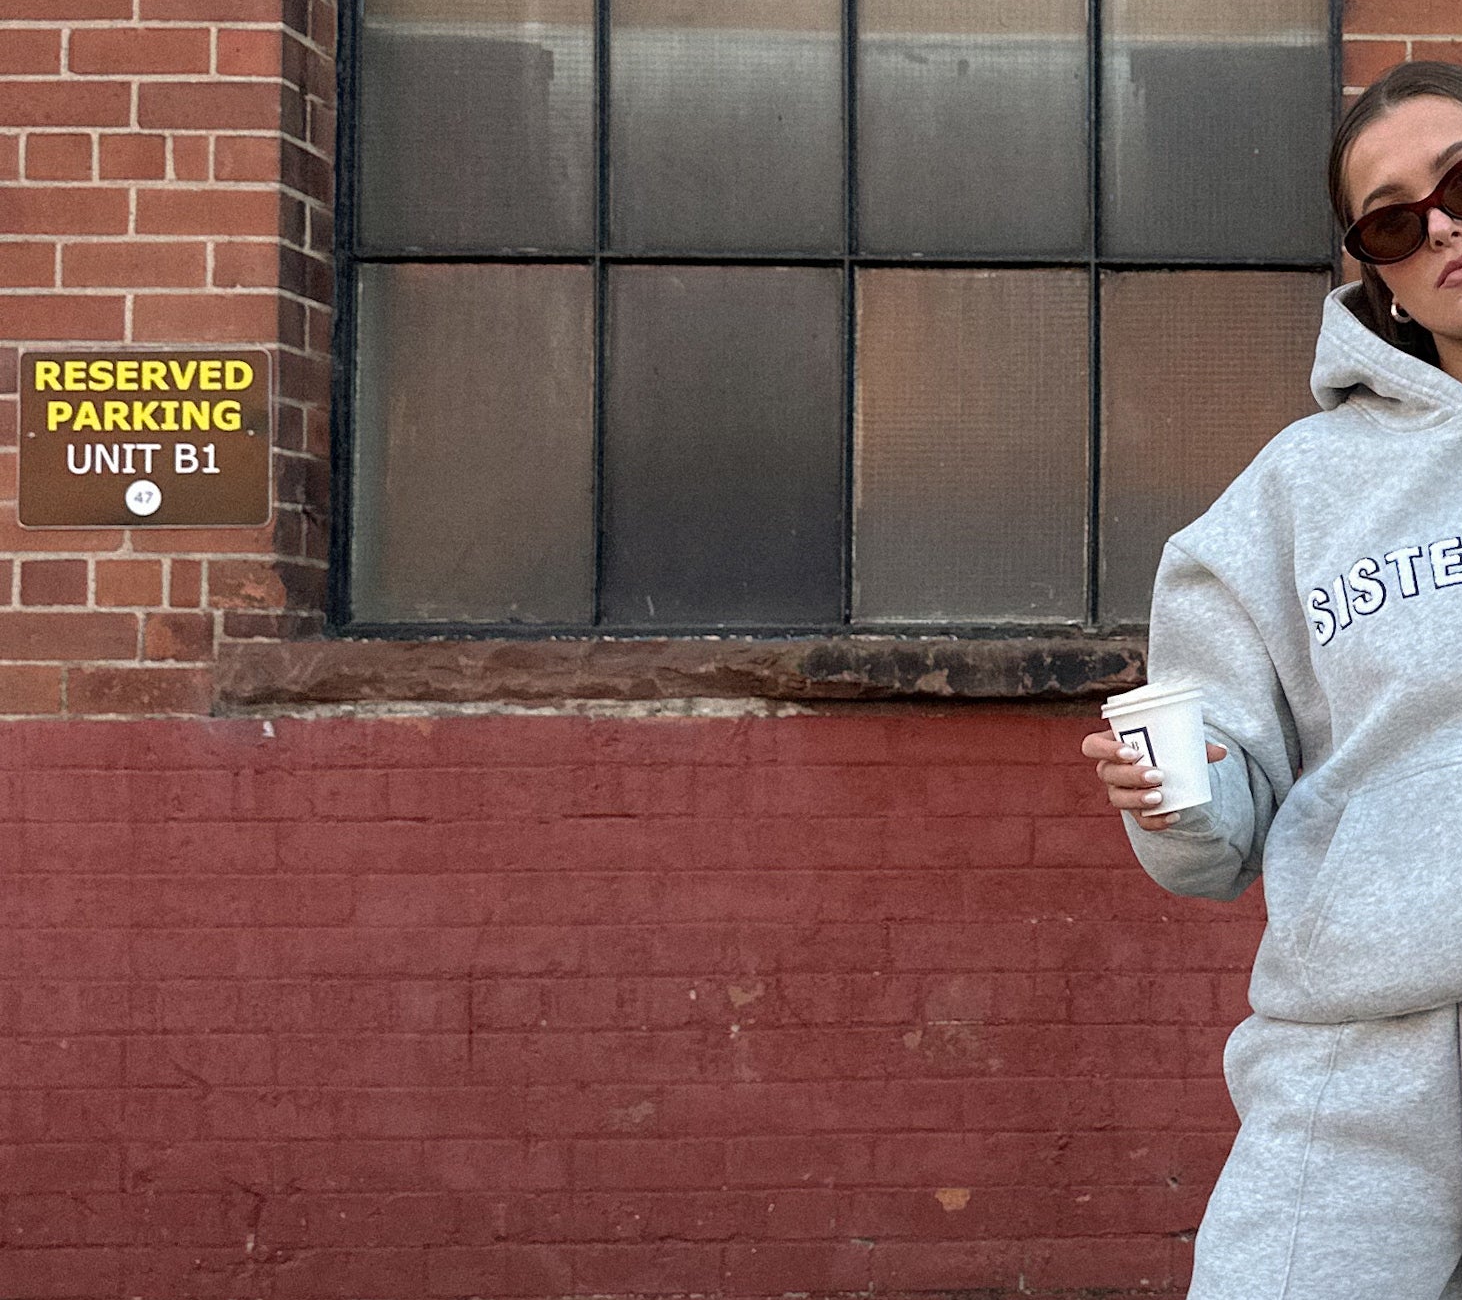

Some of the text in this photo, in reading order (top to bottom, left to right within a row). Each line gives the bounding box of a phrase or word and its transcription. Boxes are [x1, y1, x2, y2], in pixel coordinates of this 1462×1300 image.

[35, 360, 254, 391] RESERVED
[47, 400, 242, 431] PARKING
[67, 443, 220, 474] UNIT B1
[133, 491, 154, 504] 47
